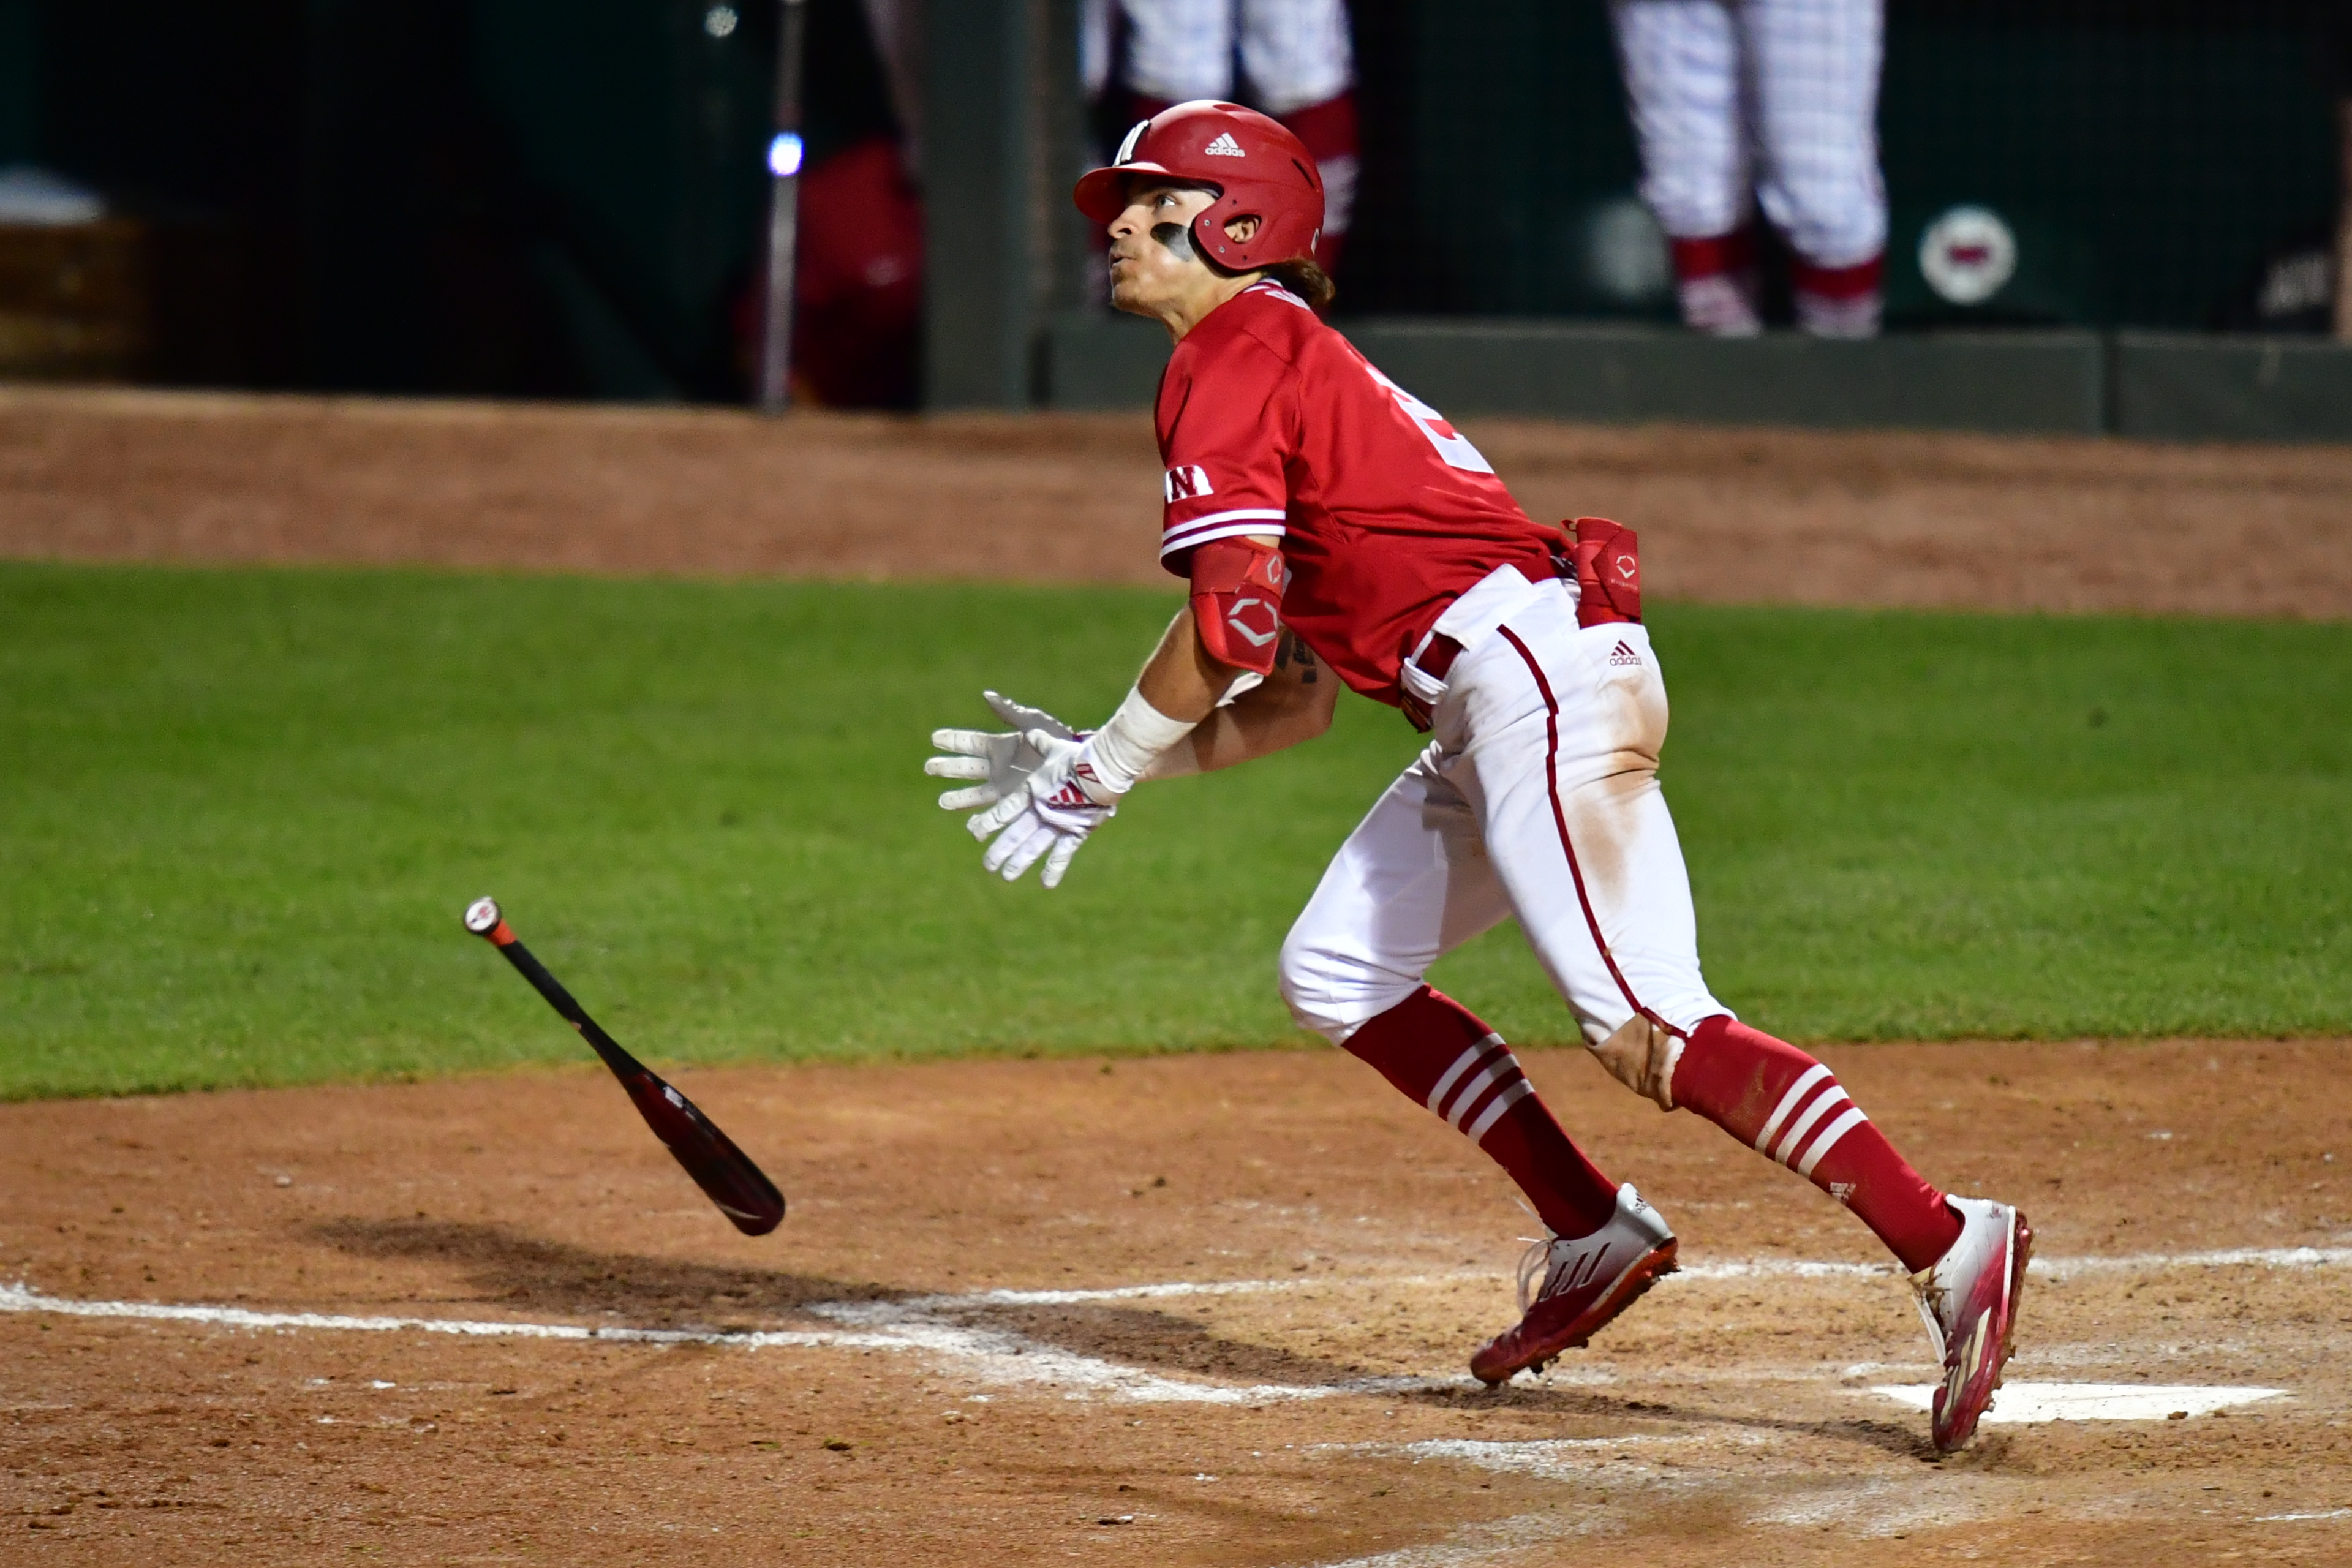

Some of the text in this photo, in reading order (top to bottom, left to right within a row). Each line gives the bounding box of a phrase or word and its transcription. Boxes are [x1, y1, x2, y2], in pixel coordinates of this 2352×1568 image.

[1205, 147, 1245, 157] adidas
[1169, 466, 1199, 502] N
[1609, 656, 1642, 666] adidas
